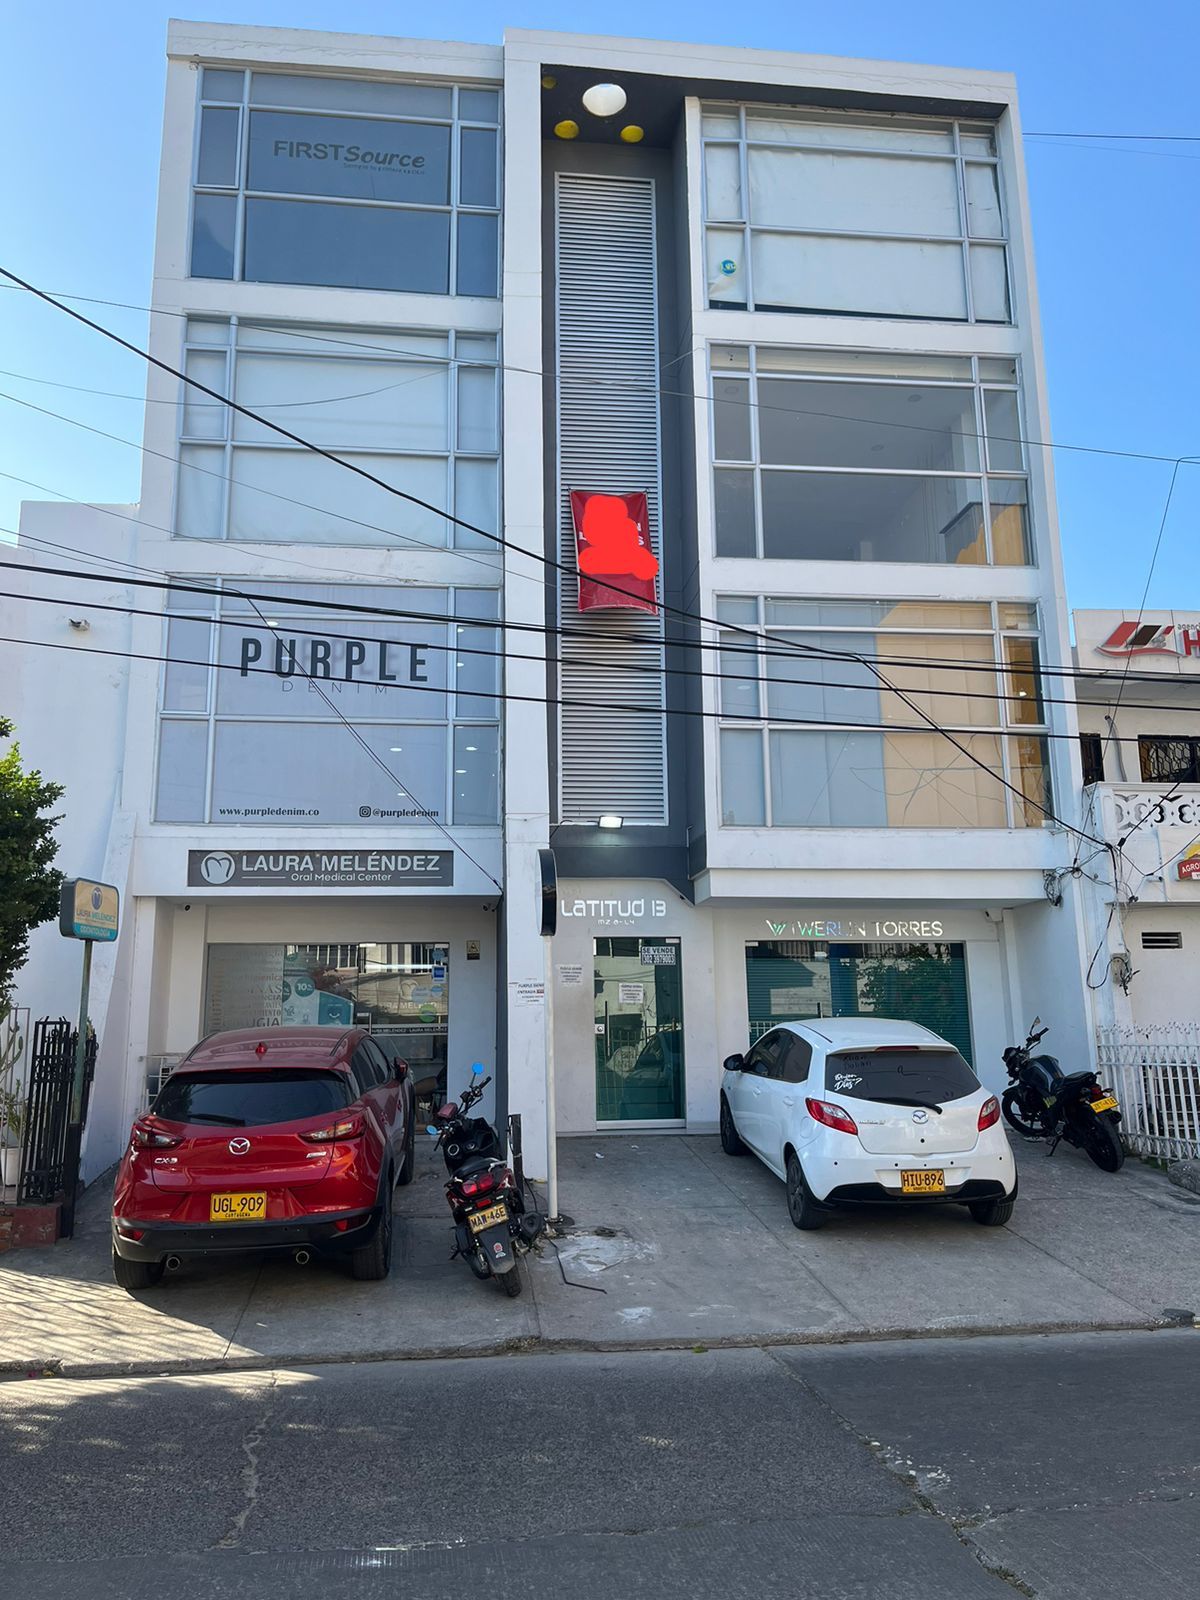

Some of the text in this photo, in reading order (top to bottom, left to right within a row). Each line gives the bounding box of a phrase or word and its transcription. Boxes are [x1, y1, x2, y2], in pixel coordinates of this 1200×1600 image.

[240, 637, 428, 682] PURPLE
[282, 681, 387, 694] DENIM
[219, 806, 320, 817] www.purpledenim.co
[372, 808, 439, 818] @purpledenim
[242, 851, 440, 871] LAURA MELÉNDEZ
[291, 873, 392, 881] Oral Medical Center
[871, 920, 943, 937] TORRES
